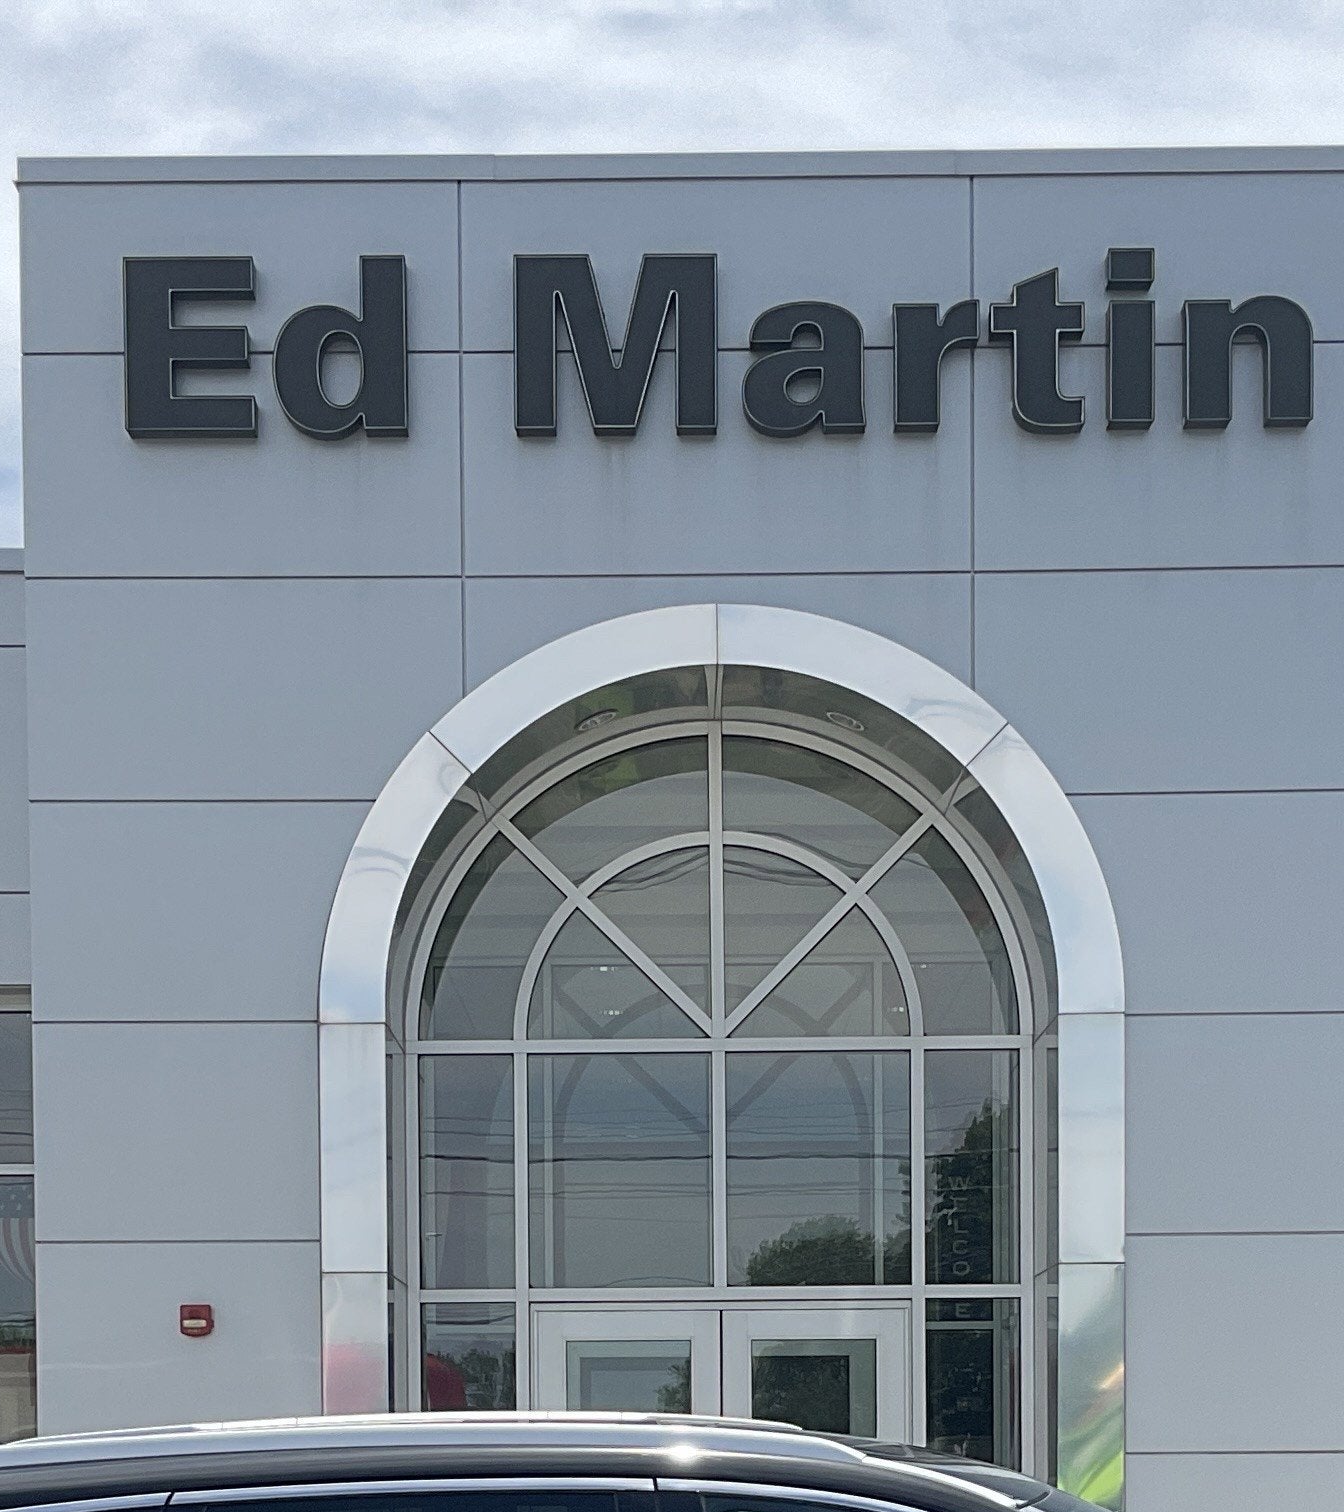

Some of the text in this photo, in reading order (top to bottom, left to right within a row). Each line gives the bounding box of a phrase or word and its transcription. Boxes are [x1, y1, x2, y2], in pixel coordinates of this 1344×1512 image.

[123, 247, 1314, 445] Ed Martin
[947, 1175, 973, 1320] WELCOE
